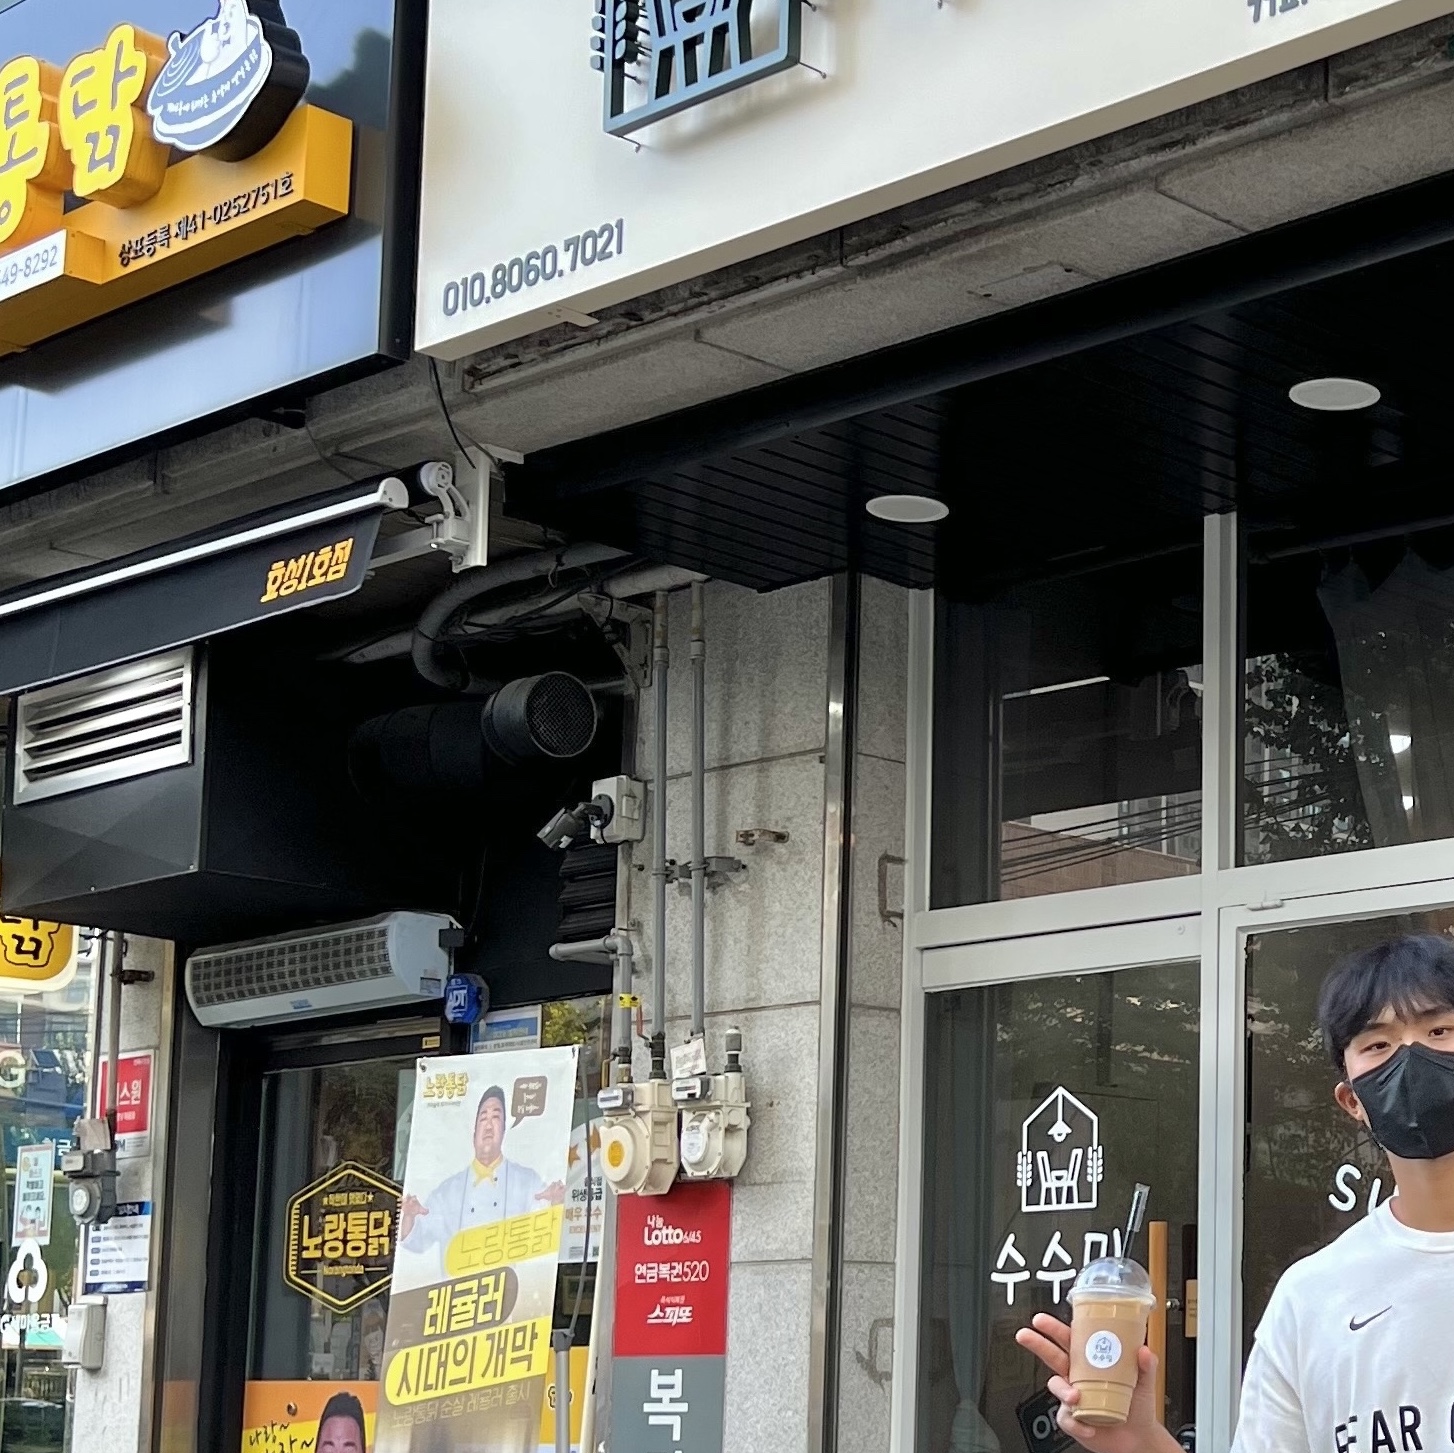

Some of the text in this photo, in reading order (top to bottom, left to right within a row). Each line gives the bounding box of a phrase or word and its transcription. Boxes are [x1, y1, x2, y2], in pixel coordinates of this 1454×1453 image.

[0, 245, 59, 287] 49-8292
[119, 222, 171, 267] 상표등록
[442, 218, 625, 318] 010.8060.7021
[260, 537, 354, 603] 효성1호점
[116, 1078, 142, 1106] 스원
[572, 1188, 603, 1203] 위생급
[301, 1210, 391, 1259] 노랑통닭
[457, 1211, 557, 1271] 노랑통닭
[634, 1260, 710, 1284] 연금복권520
[423, 1271, 506, 1337] 레귤러
[646, 1304, 693, 1326] 스피또
[396, 1321, 538, 1398] 시대의 개막
